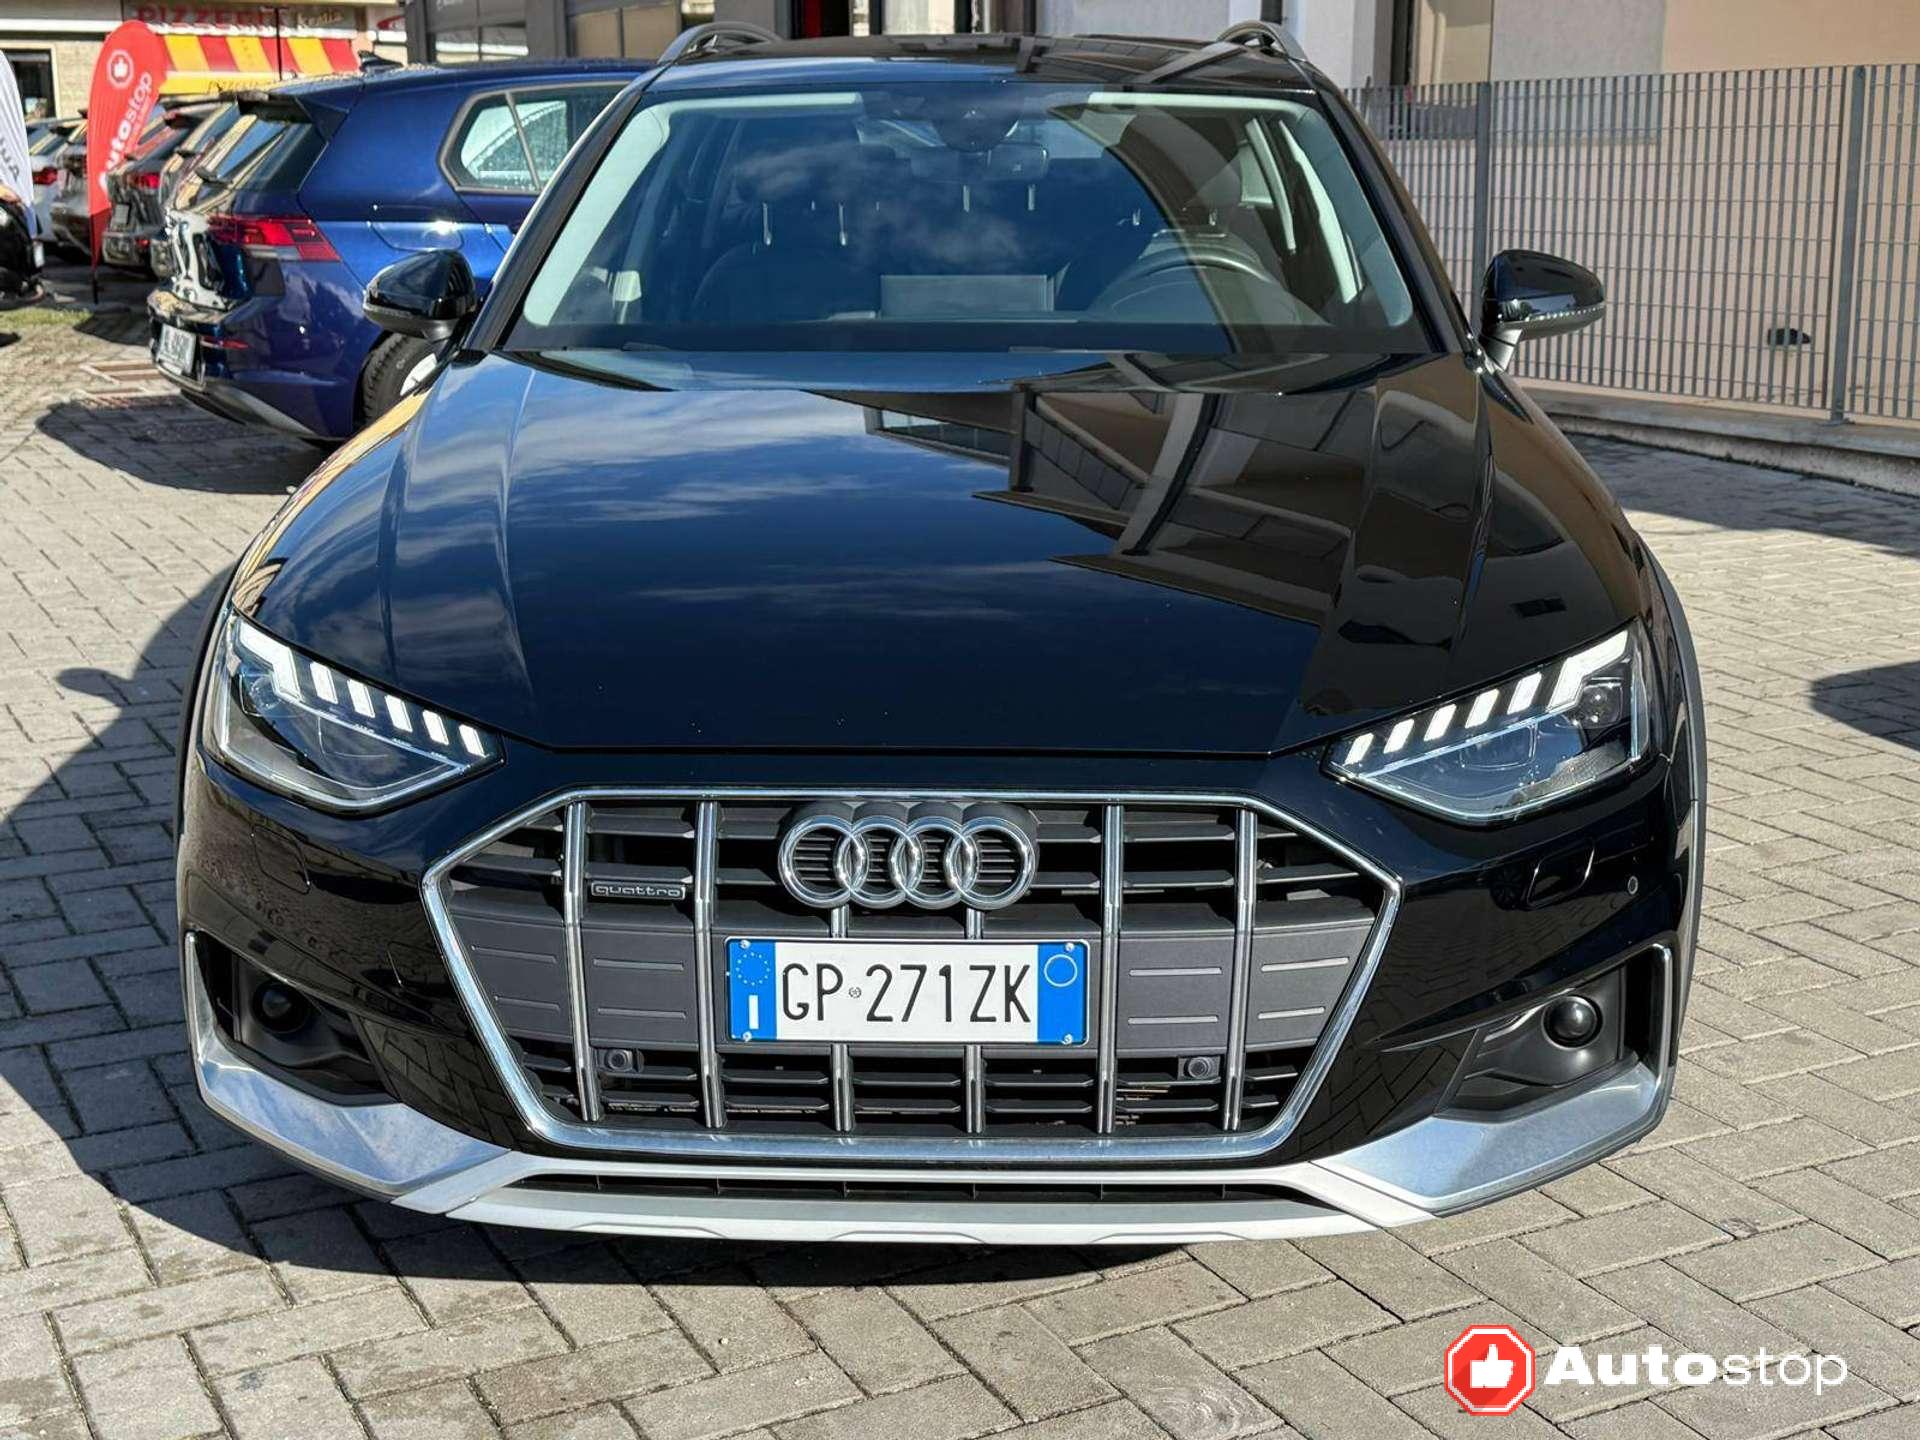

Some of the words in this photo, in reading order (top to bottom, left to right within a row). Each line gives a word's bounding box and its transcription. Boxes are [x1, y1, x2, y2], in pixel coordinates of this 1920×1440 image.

[138, 5, 288, 27] PIZZERI
[595, 885, 681, 897] quattro
[782, 963, 844, 1022] GP
[865, 964, 1031, 1023] 271ZK
